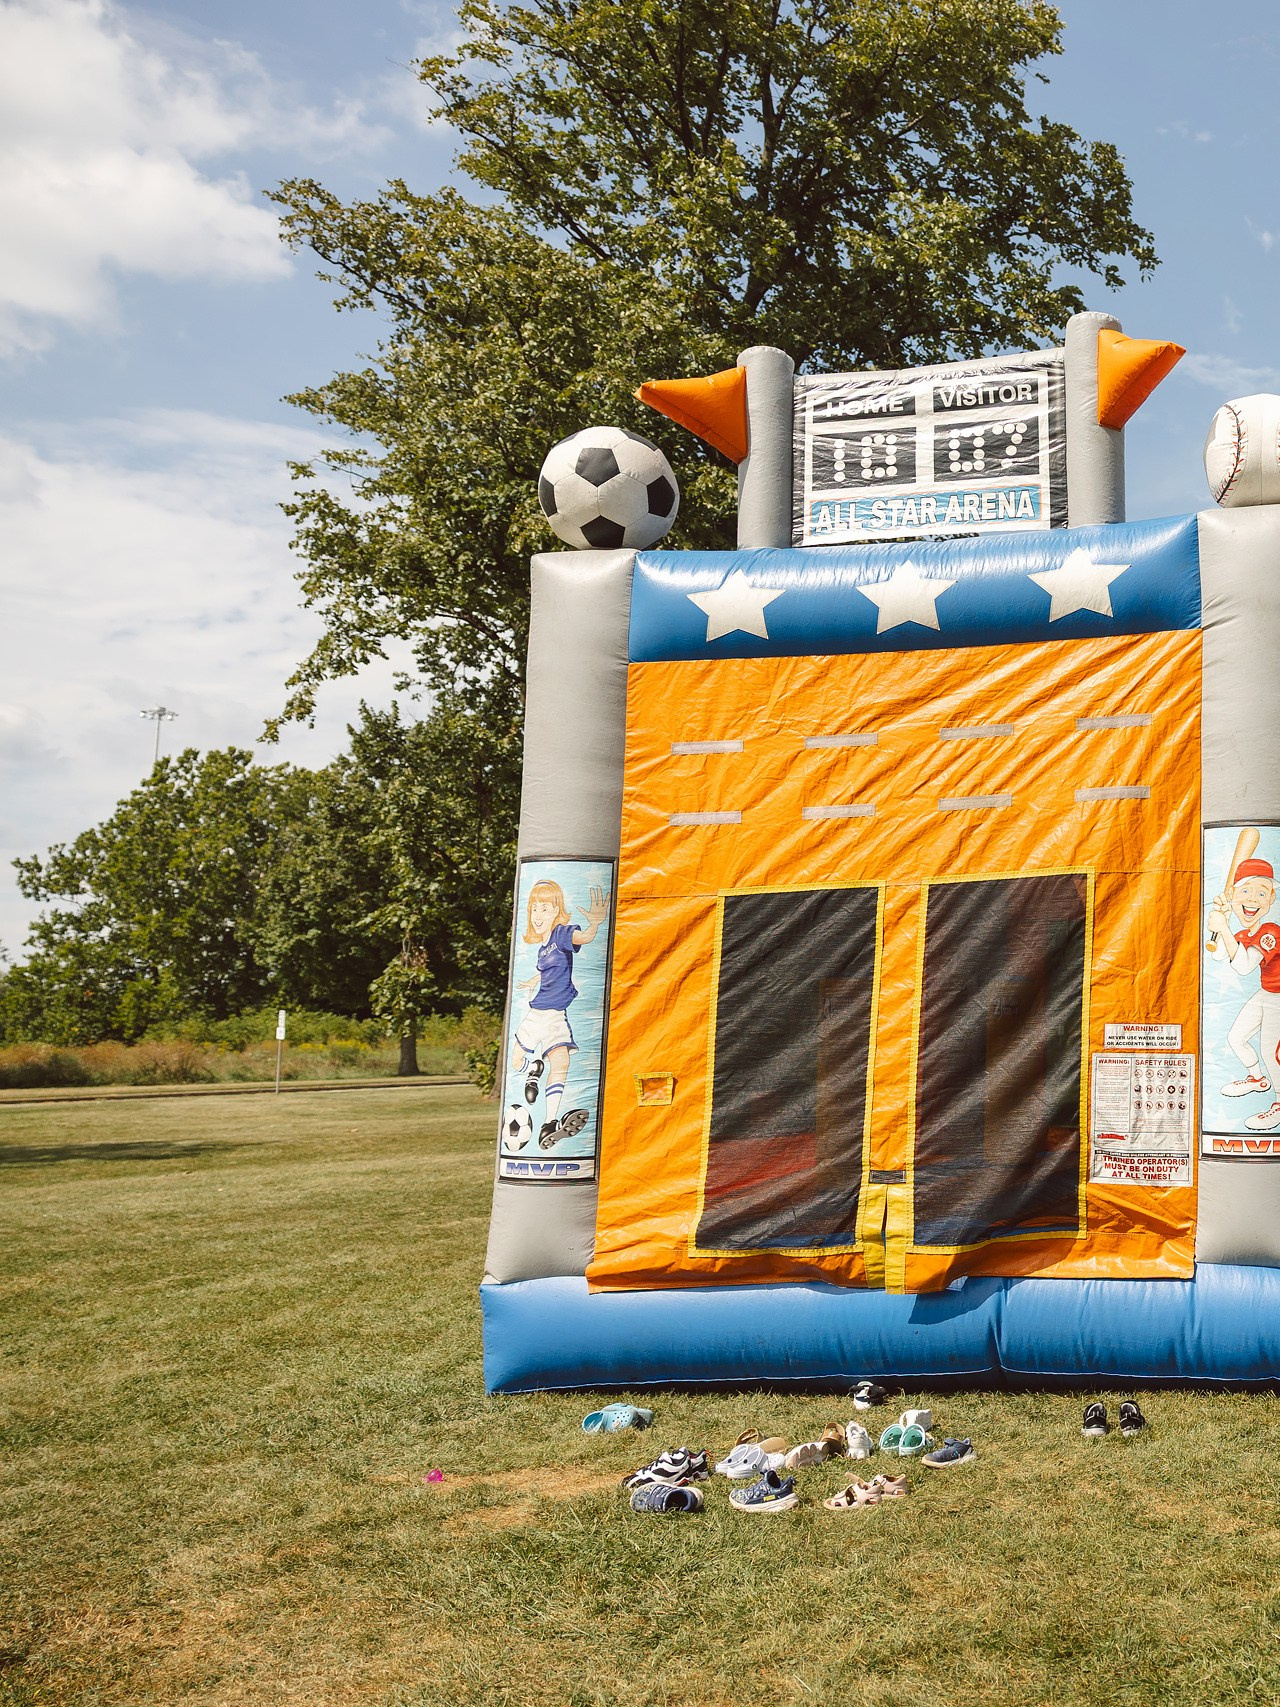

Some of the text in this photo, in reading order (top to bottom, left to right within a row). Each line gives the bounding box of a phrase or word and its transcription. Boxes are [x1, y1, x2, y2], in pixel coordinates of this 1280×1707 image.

[940, 383, 1033, 408] VISITOR
[826, 397, 904, 418] HOME
[816, 489, 1036, 533] ALL STAR ARENA
[506, 1162, 580, 1176] MVP
[1103, 1155, 1188, 1166] TRAINED OPERATOR(S)
[1104, 1163, 1128, 1171] MUST
